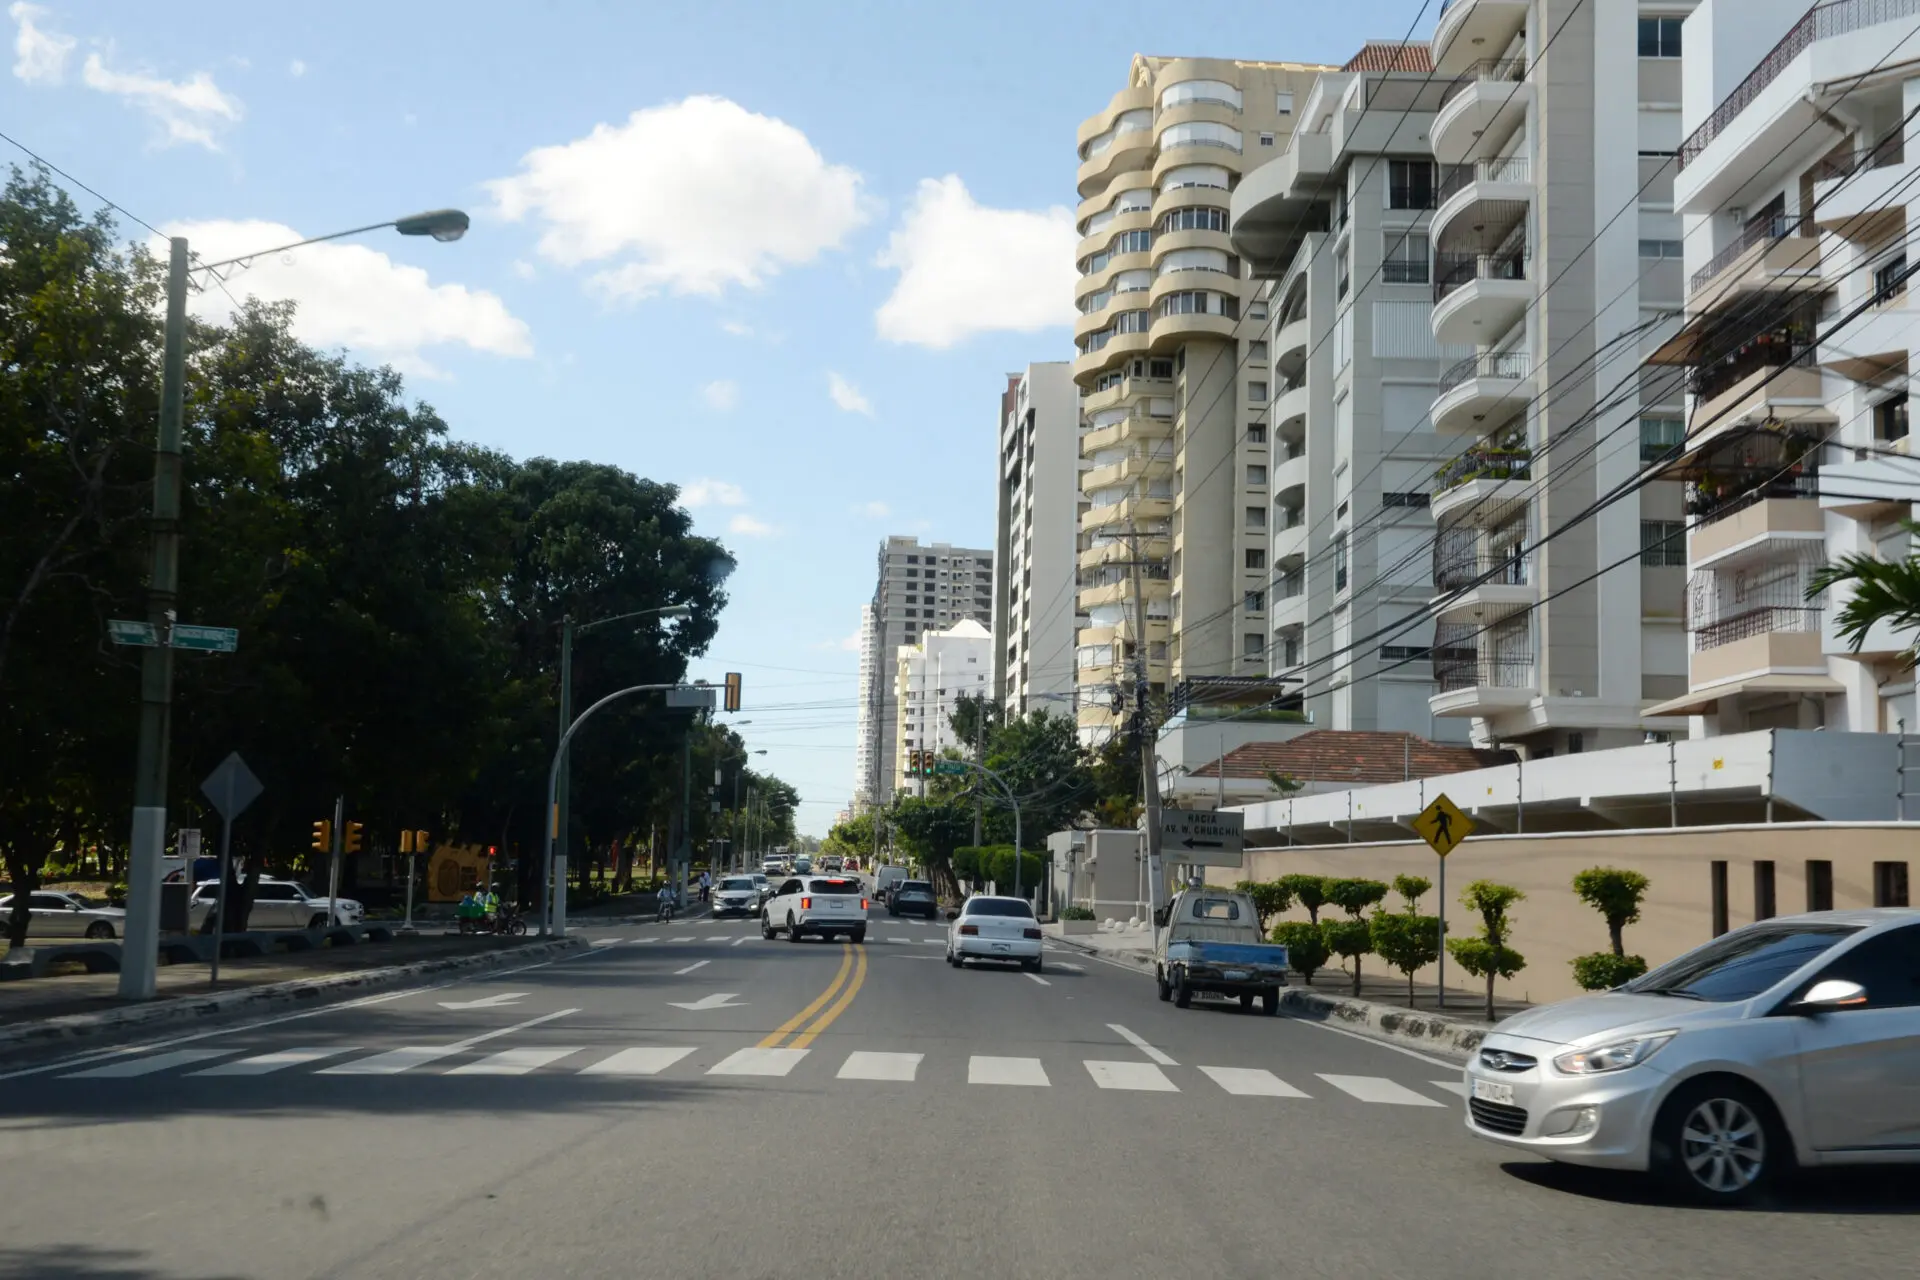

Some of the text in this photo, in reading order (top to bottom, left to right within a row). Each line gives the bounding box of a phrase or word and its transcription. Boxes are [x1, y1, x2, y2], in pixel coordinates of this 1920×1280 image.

[1188, 813, 1217, 824] HACIA
[1165, 824, 1178, 833] AV.
[1181, 825, 1191, 834] W.
